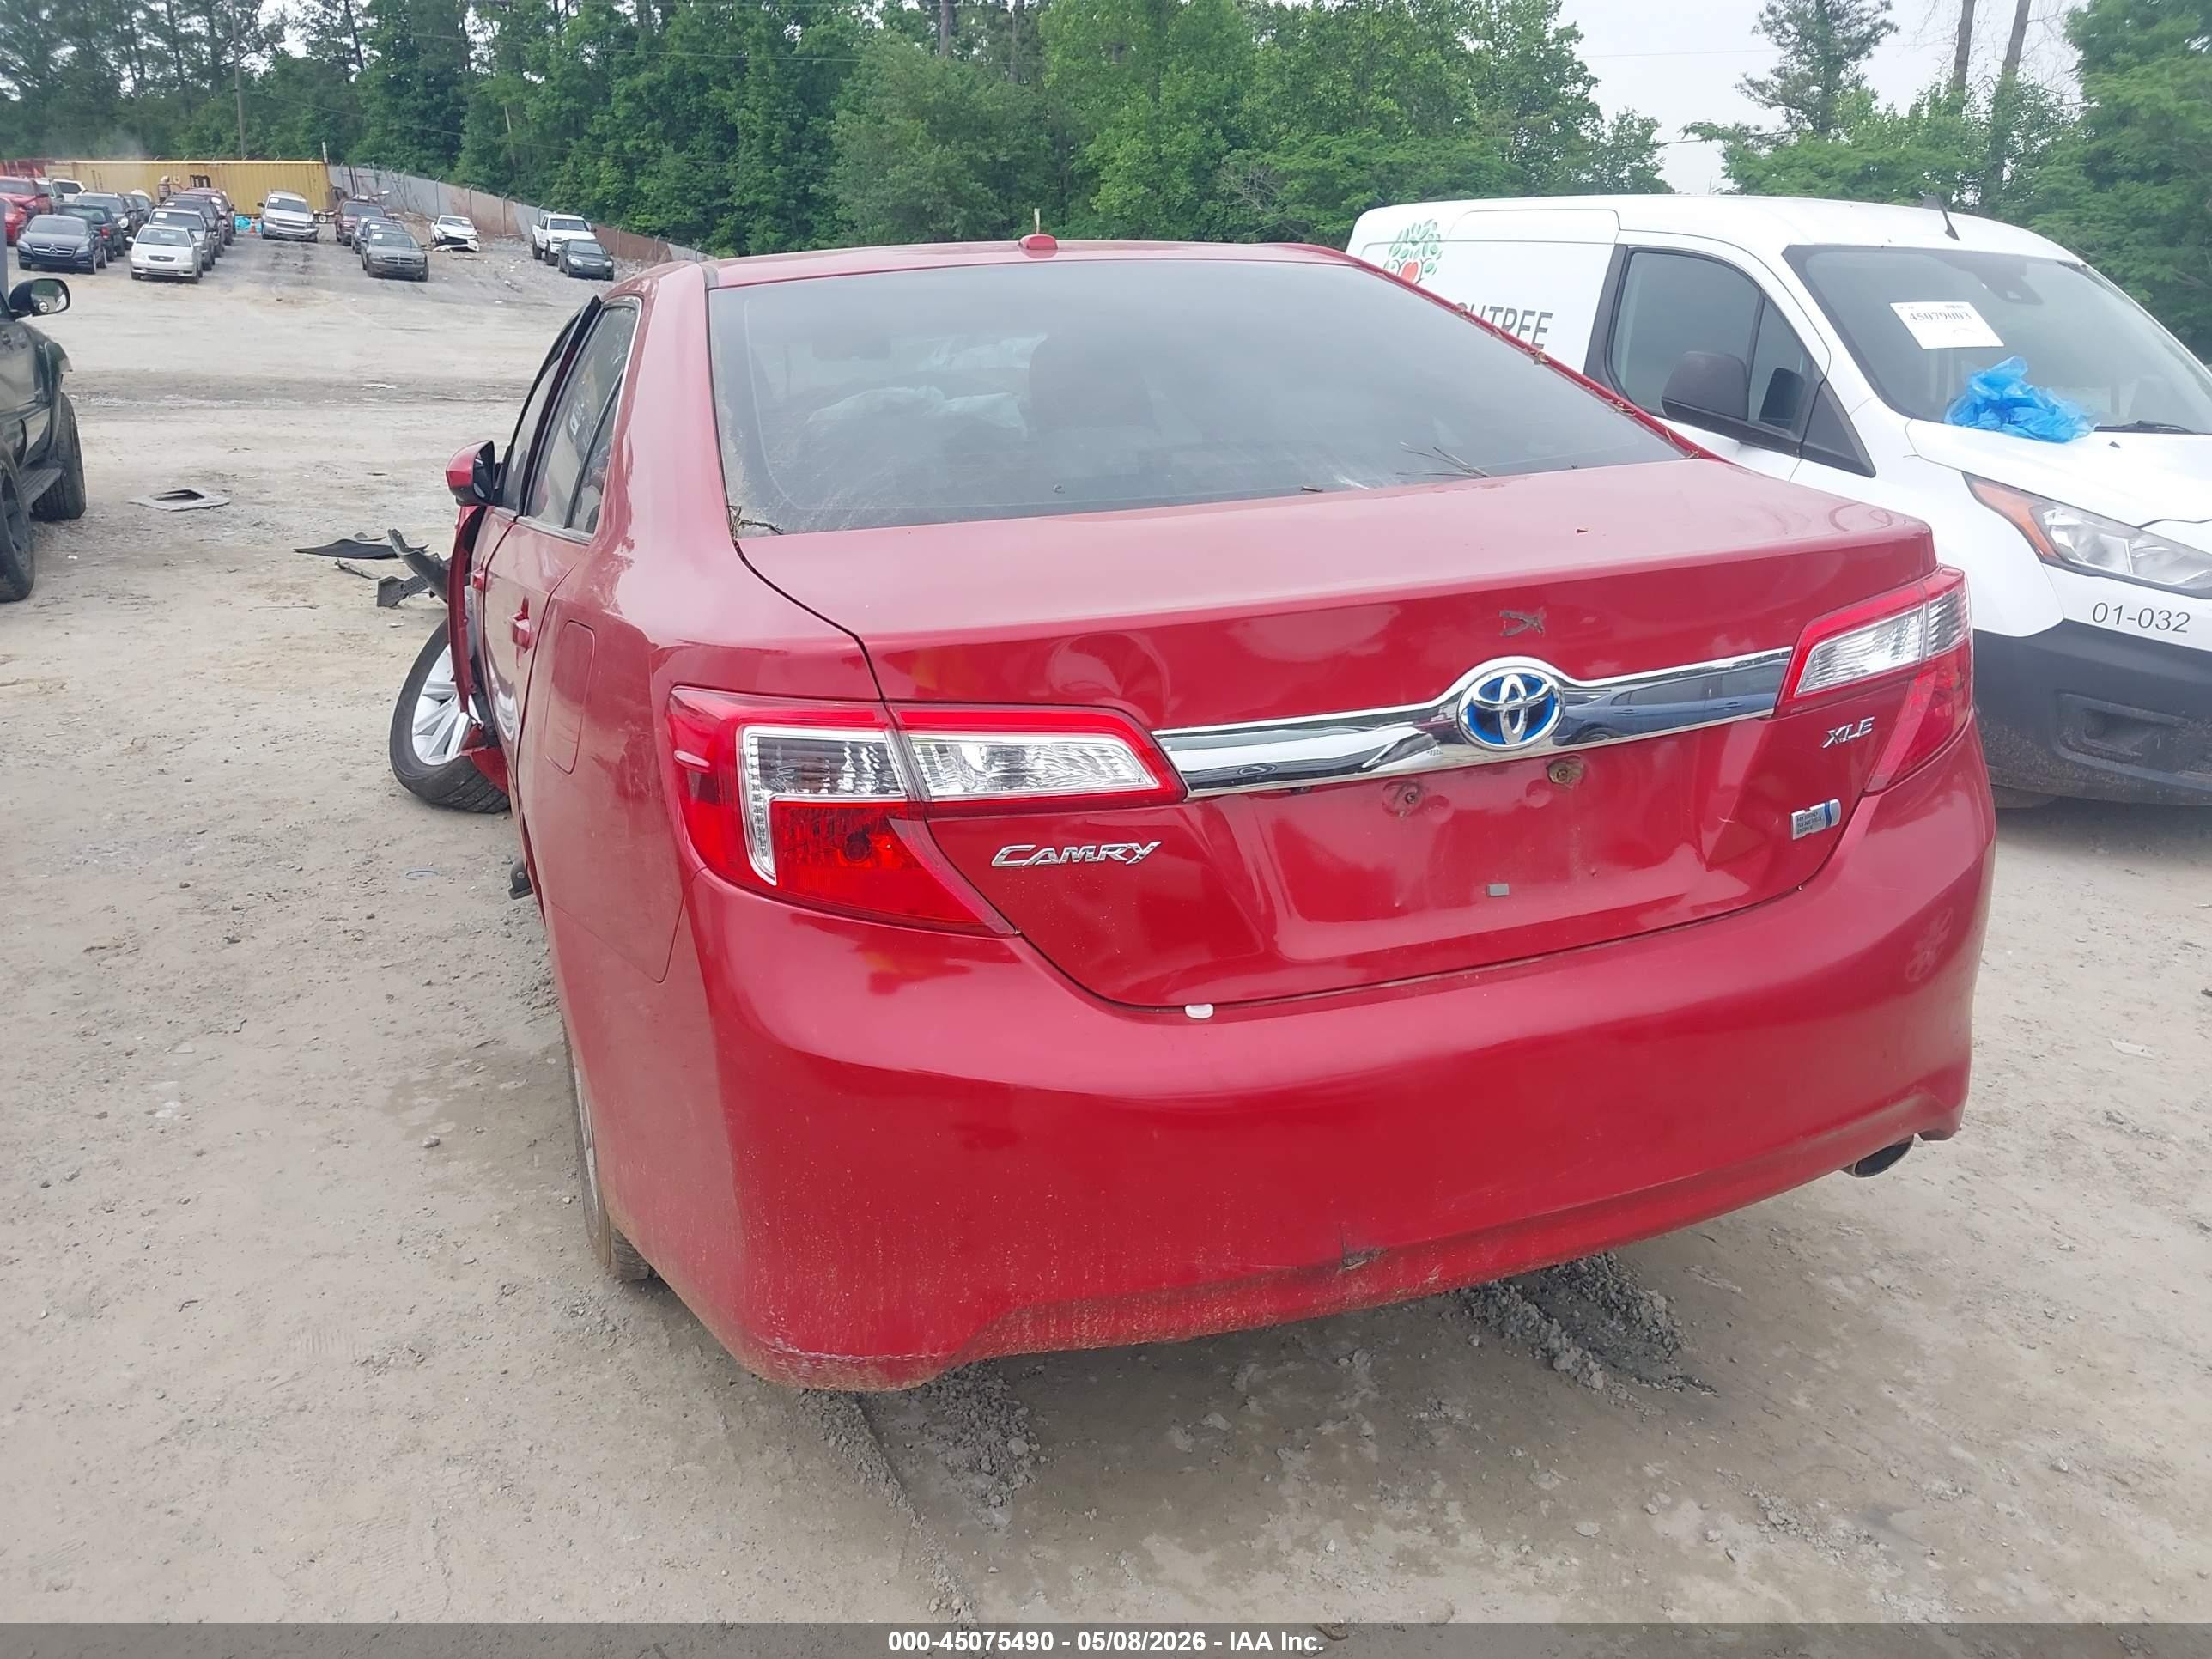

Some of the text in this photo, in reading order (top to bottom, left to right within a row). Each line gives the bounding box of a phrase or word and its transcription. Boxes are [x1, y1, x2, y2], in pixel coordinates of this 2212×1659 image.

[2092, 602, 2191, 633] 01-032
[1820, 716, 1875, 749] XLE
[991, 841, 1162, 867] CAMRY
